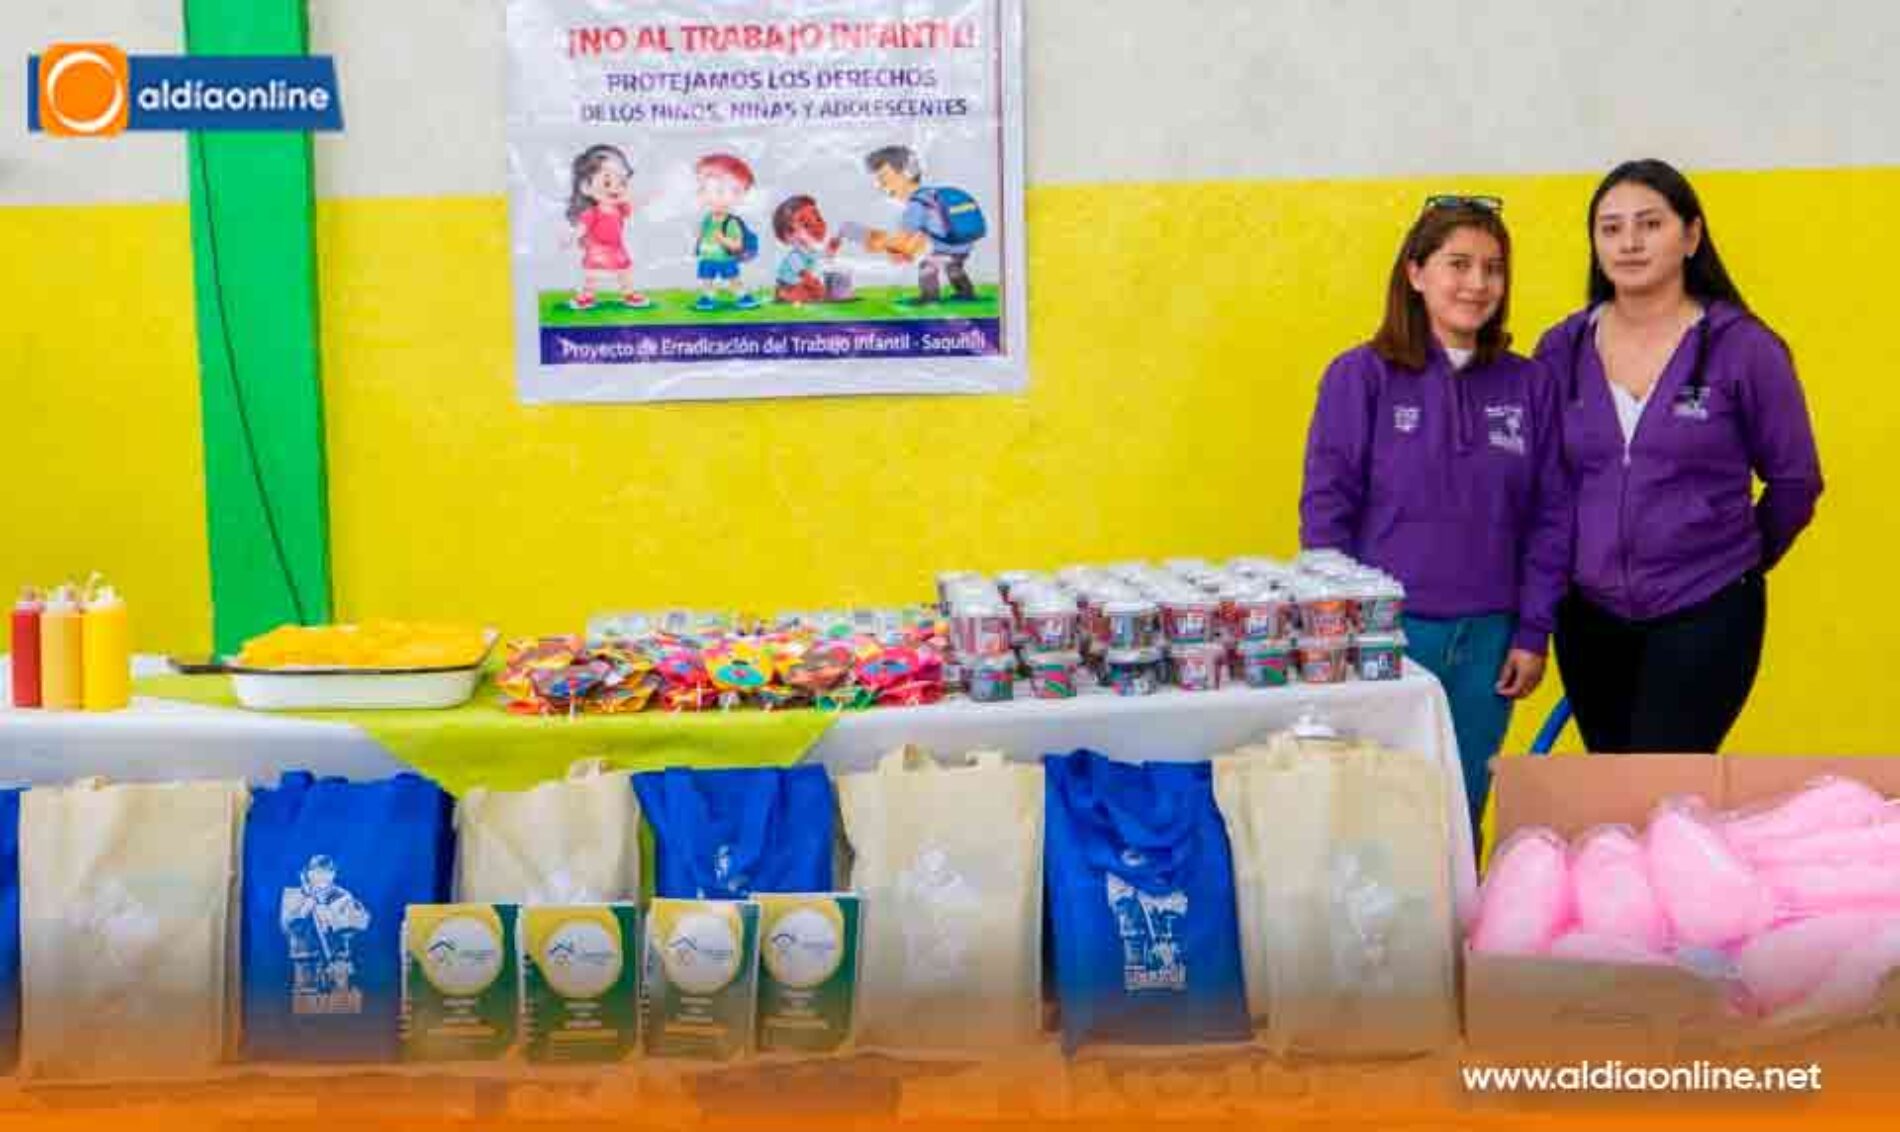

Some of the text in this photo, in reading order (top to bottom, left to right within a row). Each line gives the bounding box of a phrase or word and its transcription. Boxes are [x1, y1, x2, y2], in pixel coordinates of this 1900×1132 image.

[637, 25, 674, 51] AL
[680, 22, 823, 53] TRABAJO
[605, 66, 937, 95] PROTEJAMOS LOS DERECHOS
[581, 102, 605, 121] DE
[608, 102, 645, 121] LOS
[802, 101, 815, 116] Y
[820, 98, 967, 118] ADOLESCENTES
[561, 339, 634, 360] Proyecto
[763, 335, 788, 354] del
